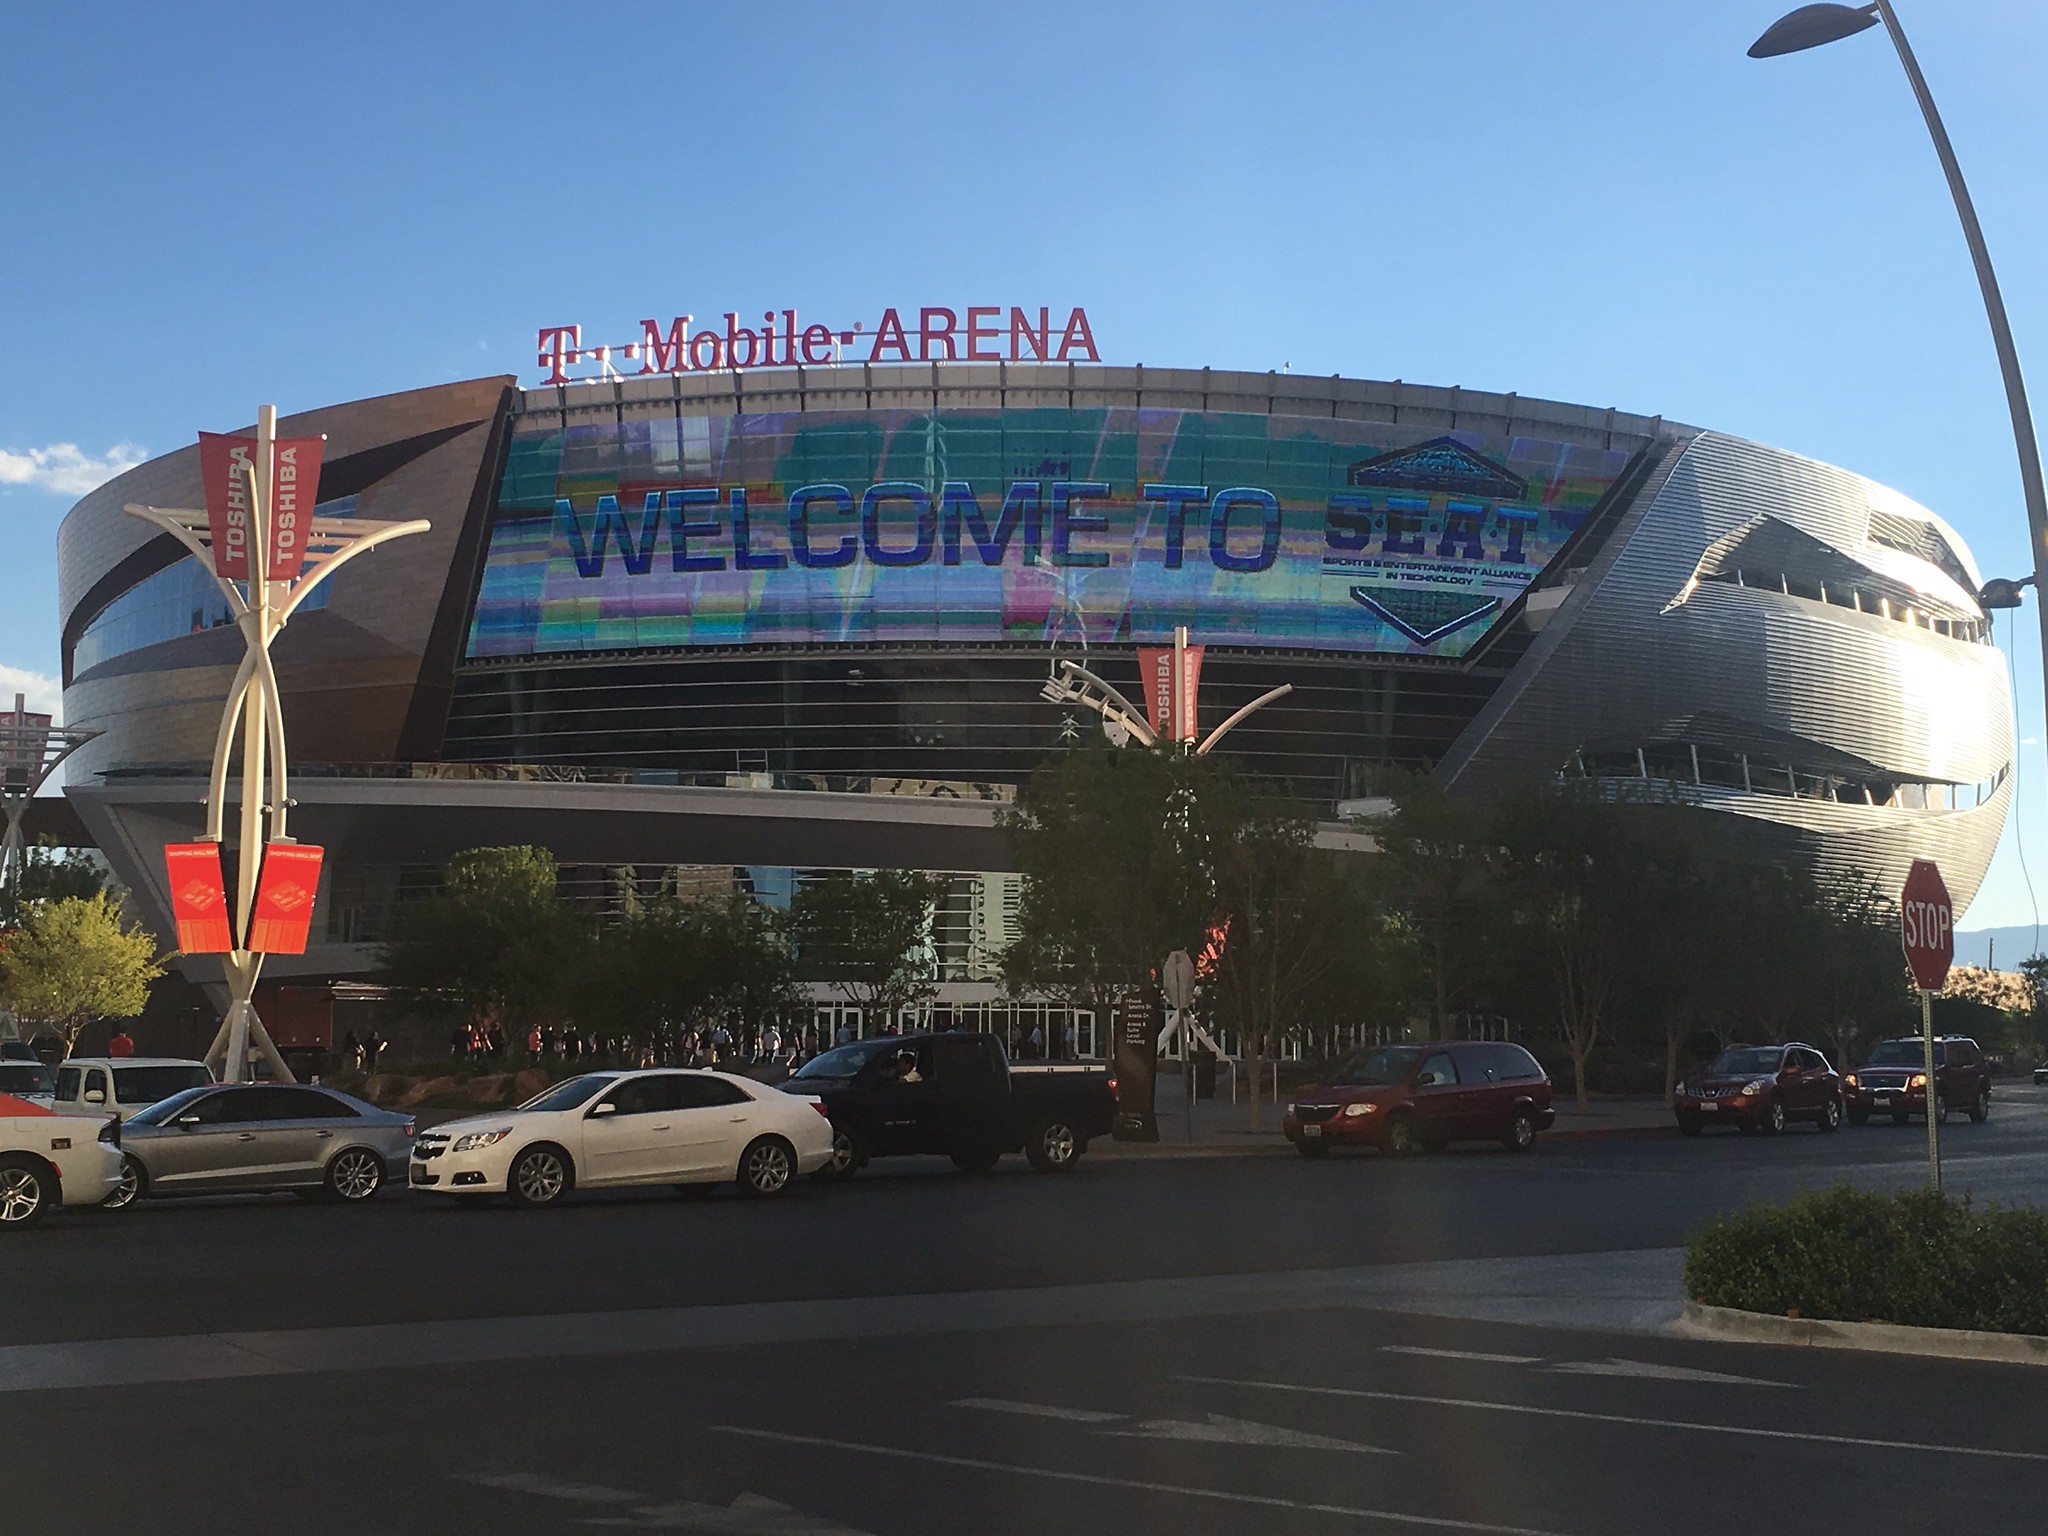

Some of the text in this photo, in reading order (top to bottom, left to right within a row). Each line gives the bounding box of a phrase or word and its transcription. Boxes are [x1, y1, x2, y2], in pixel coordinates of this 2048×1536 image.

[869, 306, 1101, 362] ARENA
[277, 447, 297, 564] TOSHIBA
[555, 482, 1283, 578] WELCOME TO
[1322, 556, 1373, 568] SPORTS
[1383, 560, 1480, 576] ENTERTAINMENT
[1480, 567, 1533, 581] ALLIANCE
[1386, 571, 1474, 585] IN TECHNOLOGY
[1905, 900, 1950, 950] STOP
